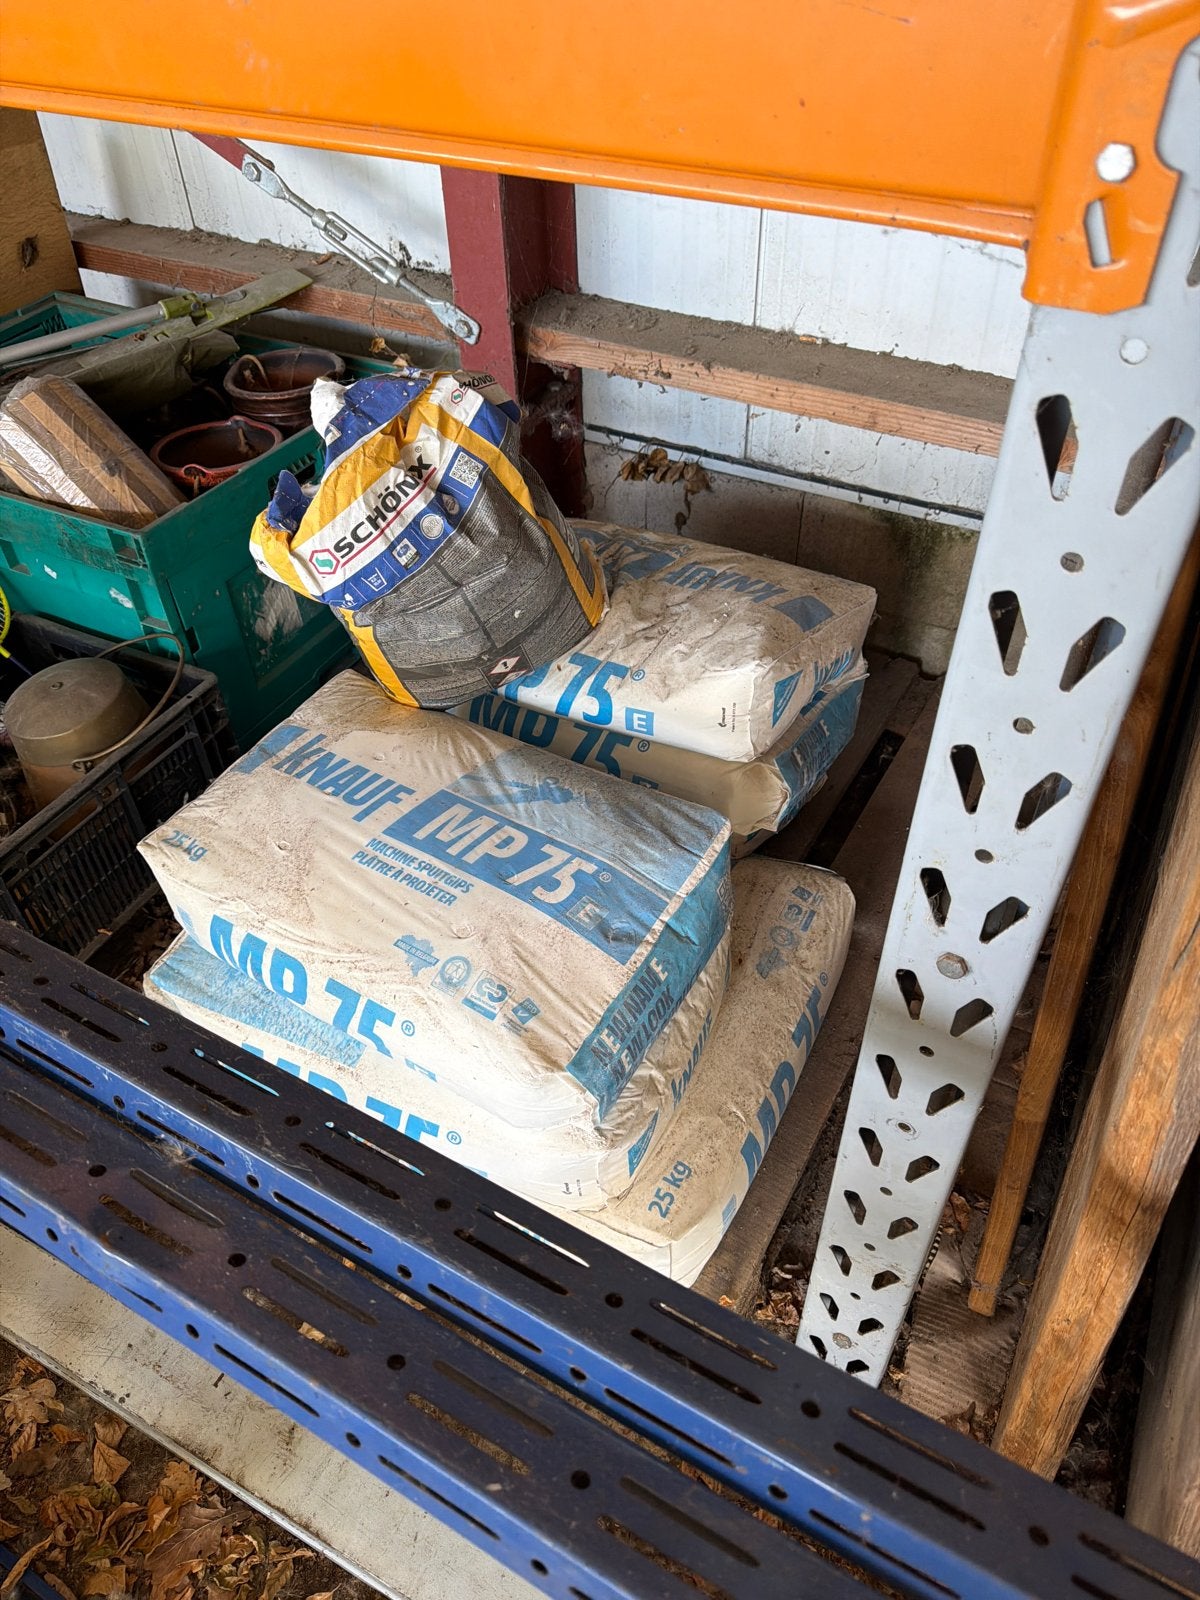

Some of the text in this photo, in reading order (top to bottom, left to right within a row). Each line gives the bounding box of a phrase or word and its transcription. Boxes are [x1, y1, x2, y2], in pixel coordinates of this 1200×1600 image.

[273, 734, 416, 822] KNAUF
[413, 804, 529, 866] MP
[161, 830, 208, 862] 25 kg
[364, 837, 475, 894] MACHINE SPUITGIPS
[399, 872, 458, 907] PROJETER
[647, 1160, 693, 1219] 25 kg
